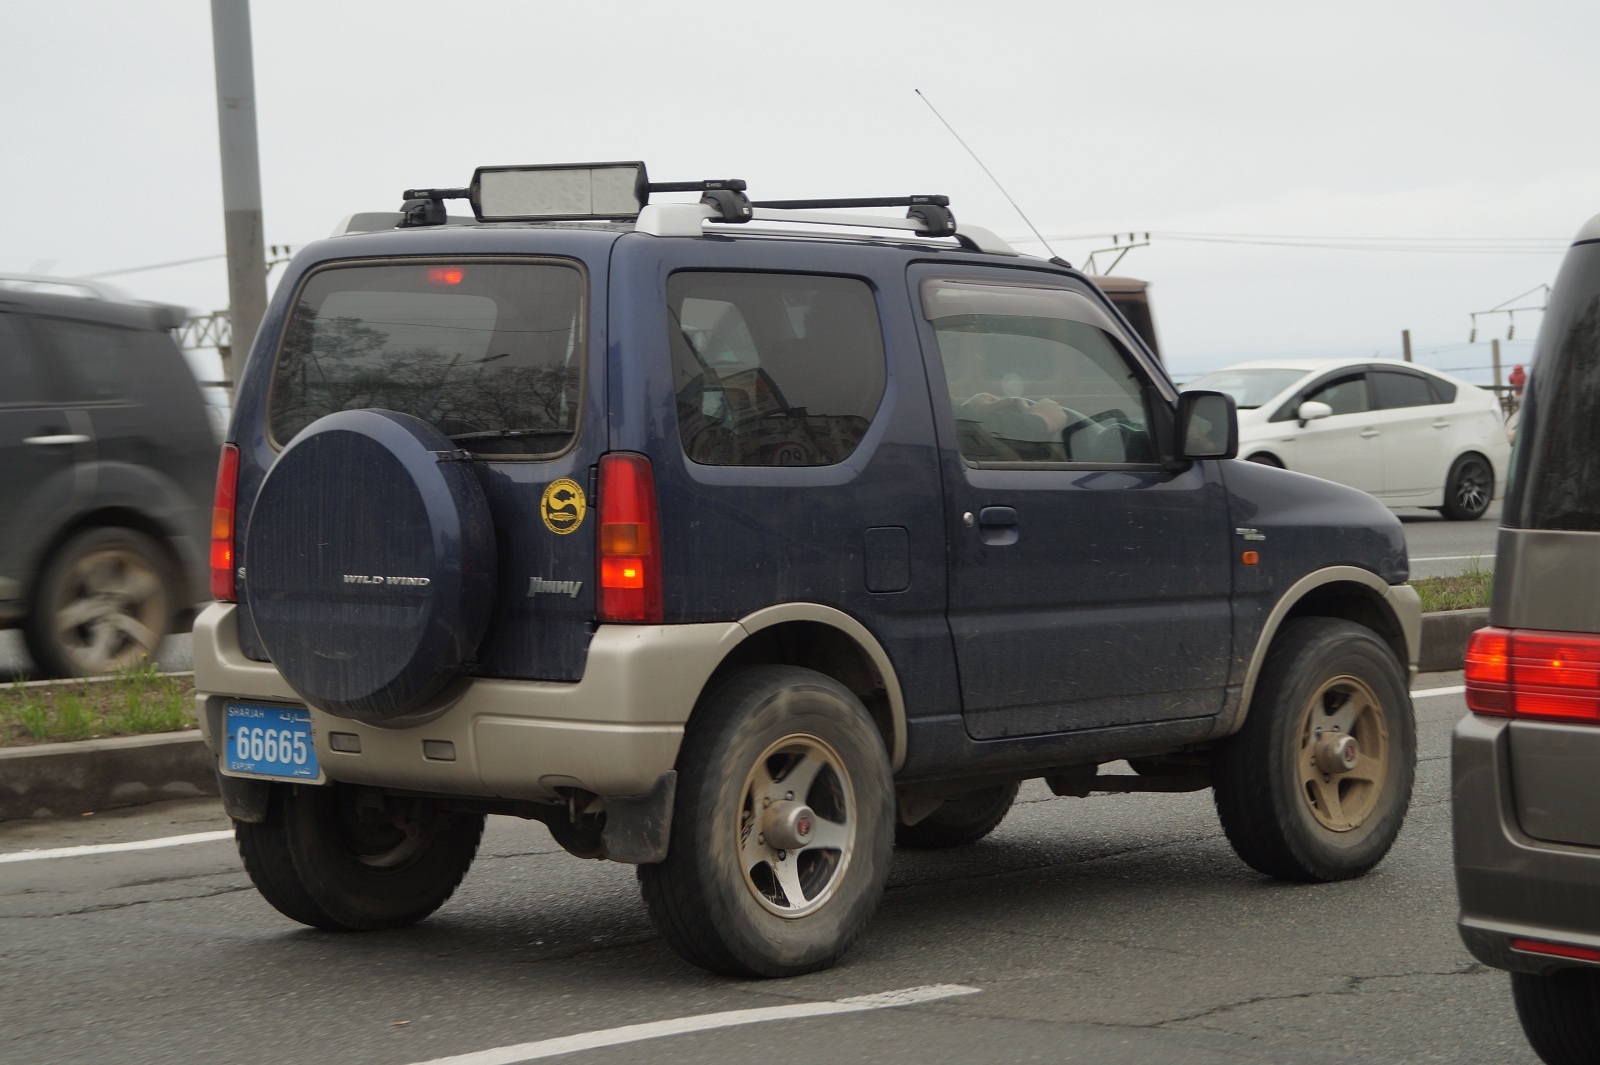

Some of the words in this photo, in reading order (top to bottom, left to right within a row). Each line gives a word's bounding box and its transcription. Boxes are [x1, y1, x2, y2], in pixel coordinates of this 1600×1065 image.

[343, 574, 384, 585] WILD
[386, 575, 431, 586] WIND
[527, 576, 583, 598] Jimny
[228, 707, 264, 718] SHARJAH
[236, 726, 307, 764] 66665
